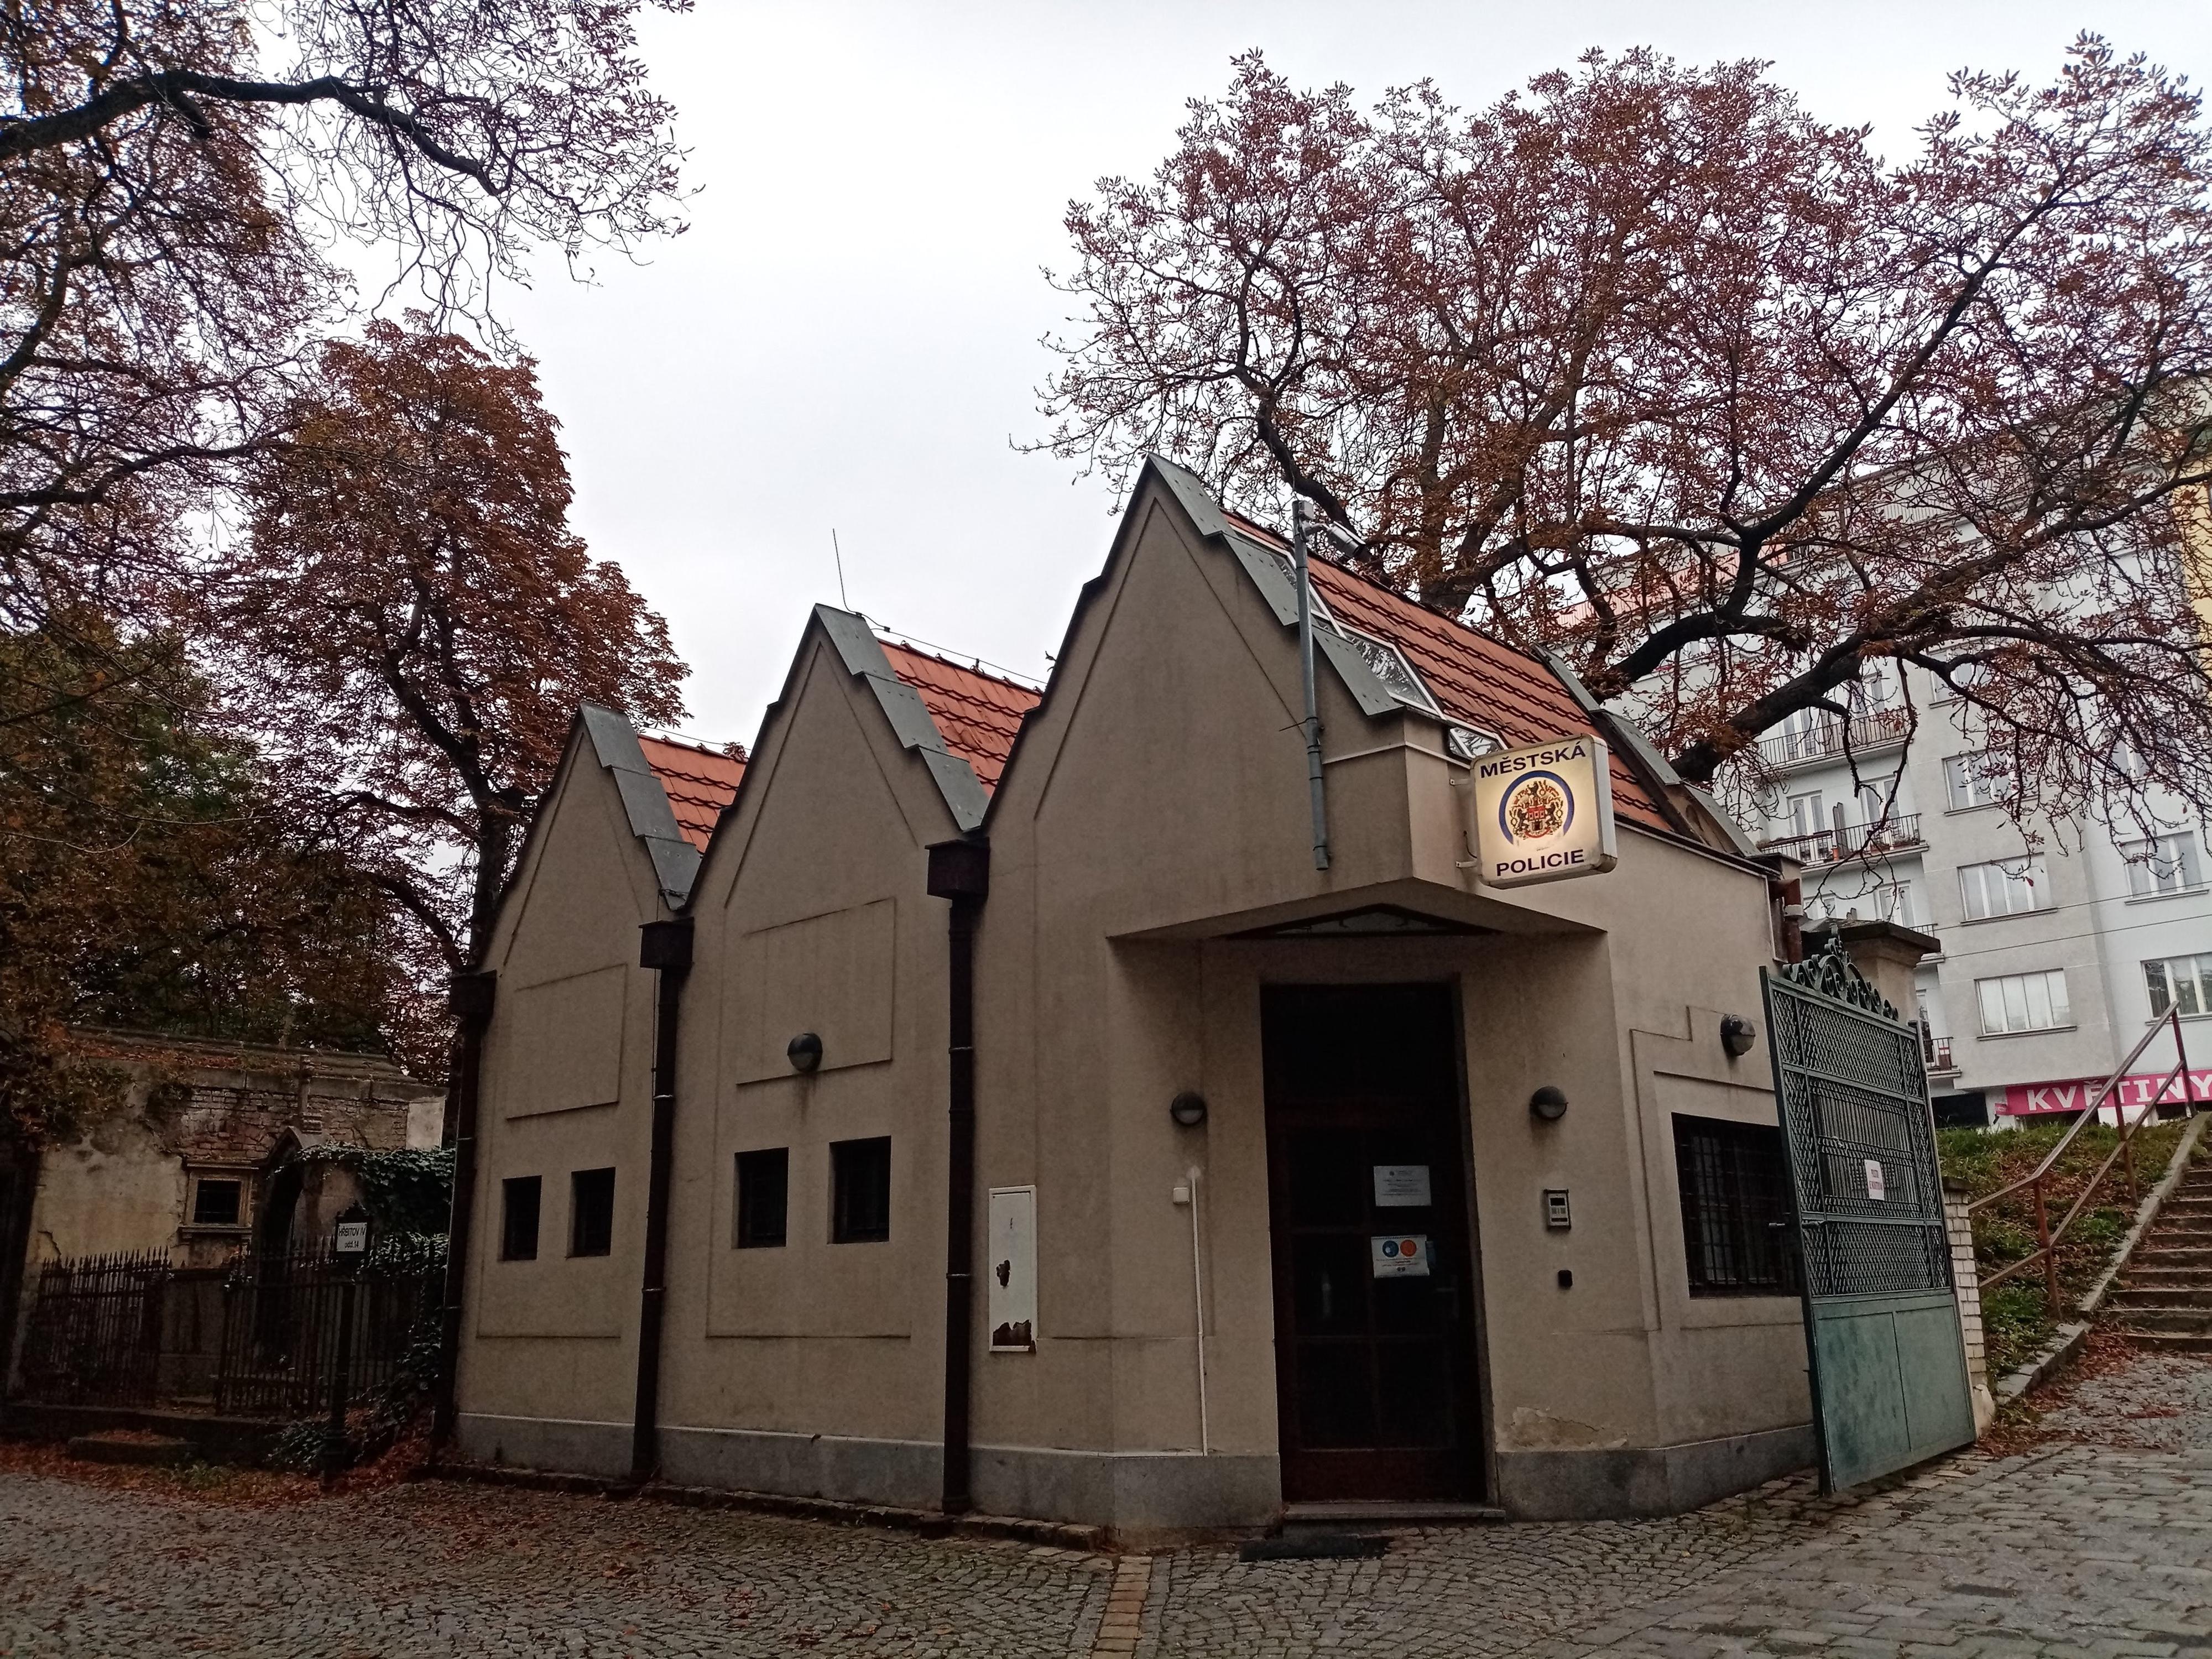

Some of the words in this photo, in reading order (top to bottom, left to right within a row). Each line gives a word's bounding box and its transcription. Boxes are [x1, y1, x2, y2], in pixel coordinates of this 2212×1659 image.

[1480, 742, 1586, 778] MĚSTSKÁ
[1496, 849, 1584, 877] POLICIE
[2027, 1074, 2212, 1111] KVĚTINY
